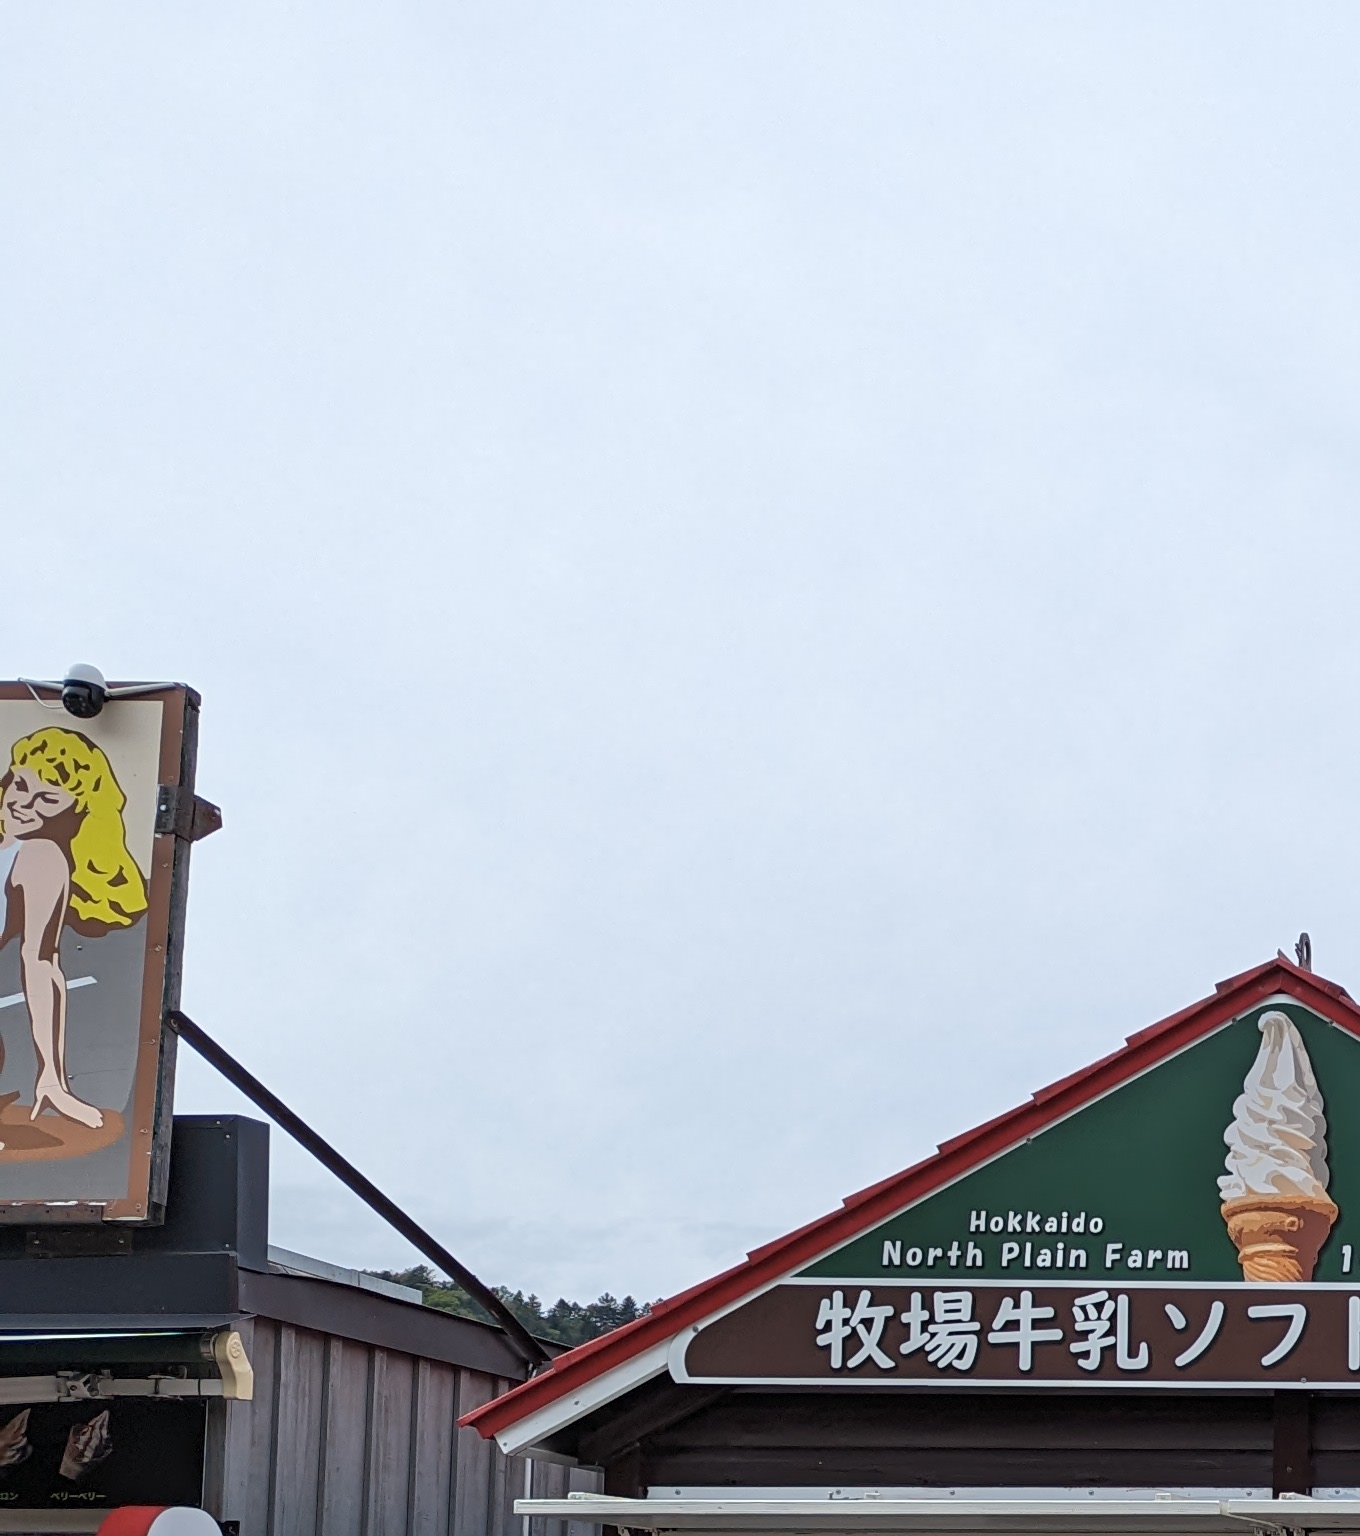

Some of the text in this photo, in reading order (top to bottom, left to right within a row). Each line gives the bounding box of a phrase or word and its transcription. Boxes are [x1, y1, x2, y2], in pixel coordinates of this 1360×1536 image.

[969, 1210, 1104, 1234] Hokkaido
[881, 1240, 1190, 1269] North Plain Farm
